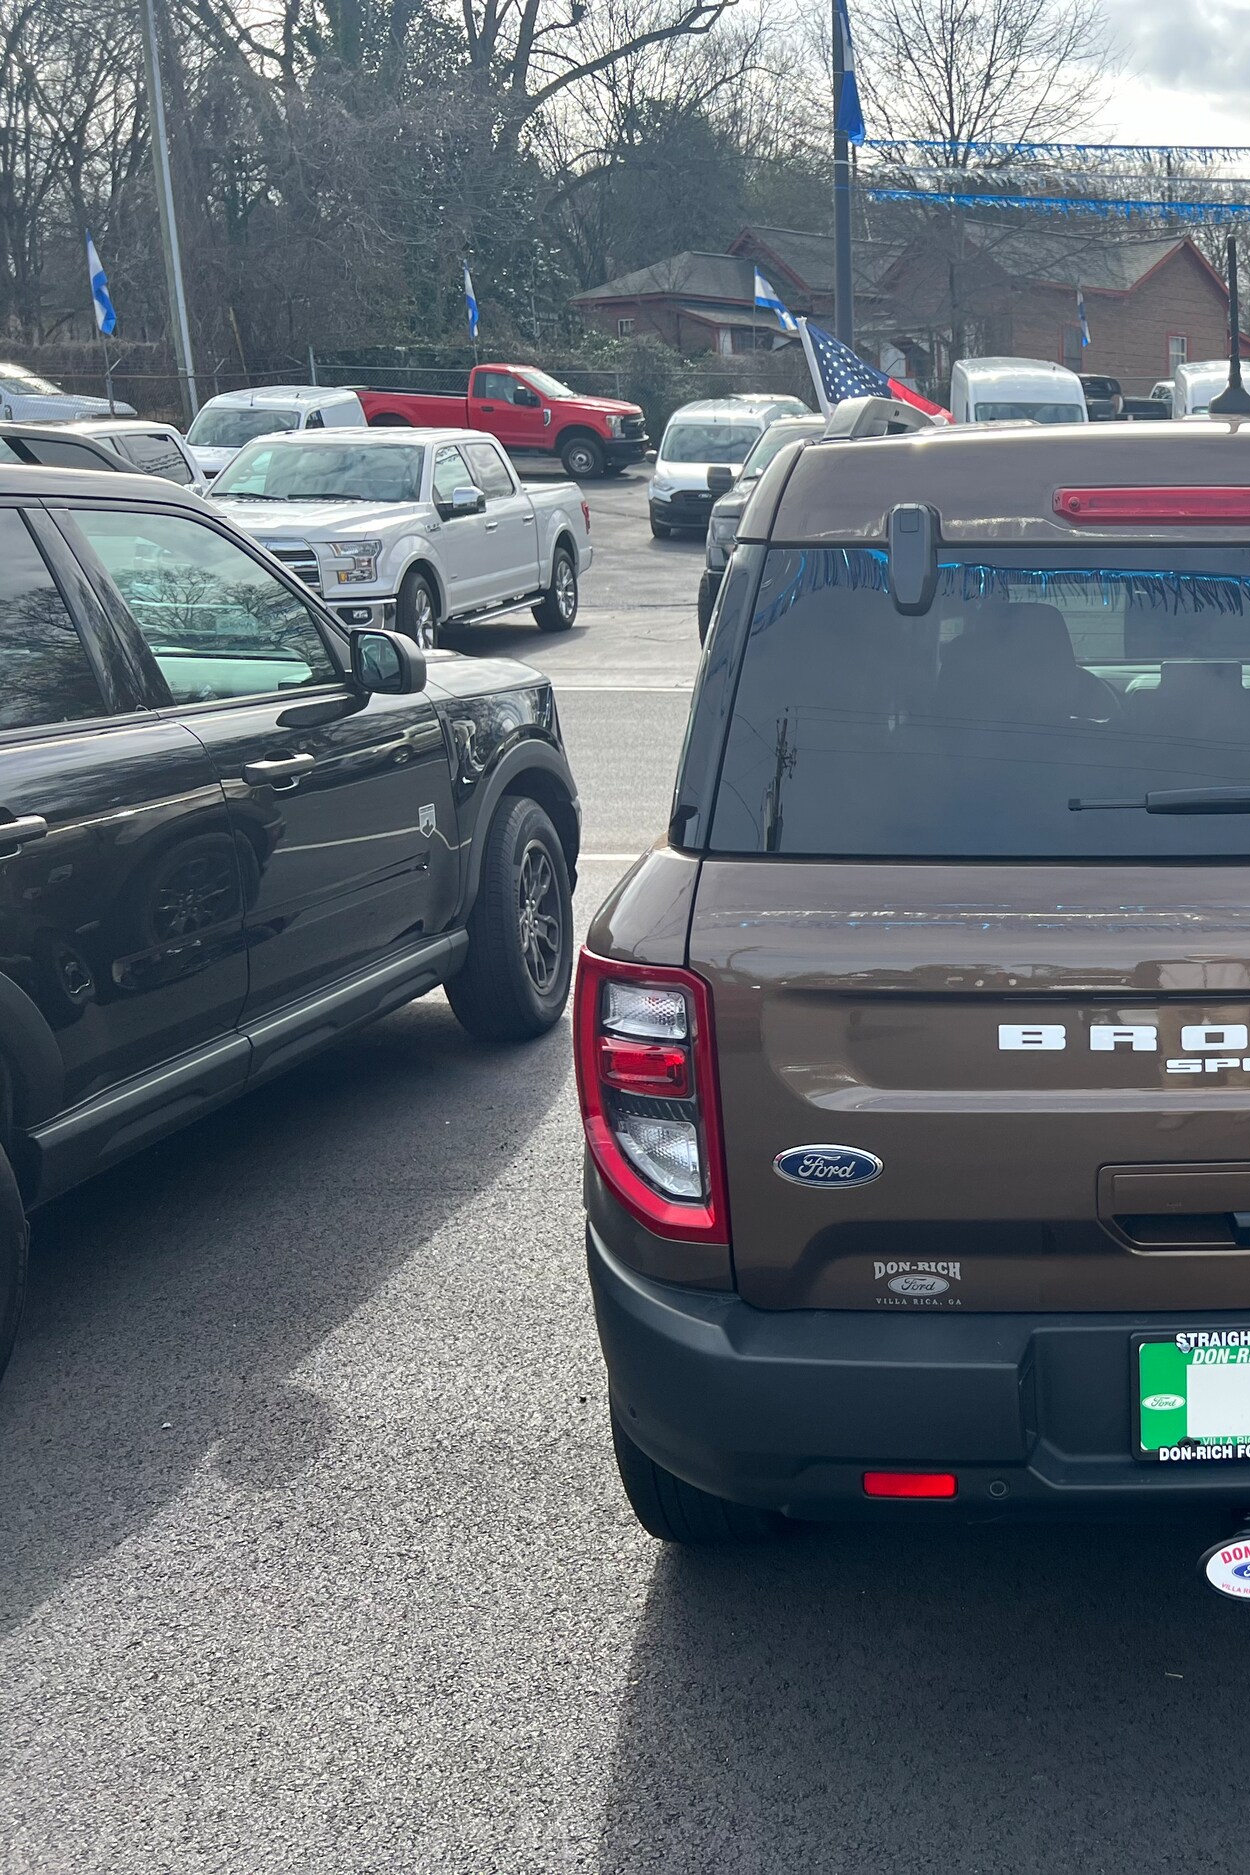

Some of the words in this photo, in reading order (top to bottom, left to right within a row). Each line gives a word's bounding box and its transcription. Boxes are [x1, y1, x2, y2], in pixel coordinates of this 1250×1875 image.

[797, 1153, 855, 1178] Ford
[873, 1261, 961, 1281] DON-RICH
[901, 1277, 936, 1292] Ford
[1150, 1395, 1178, 1408] Ford
[1159, 1444, 1234, 1461] DON-RICH
[1221, 1582, 1241, 1593] VILLA
